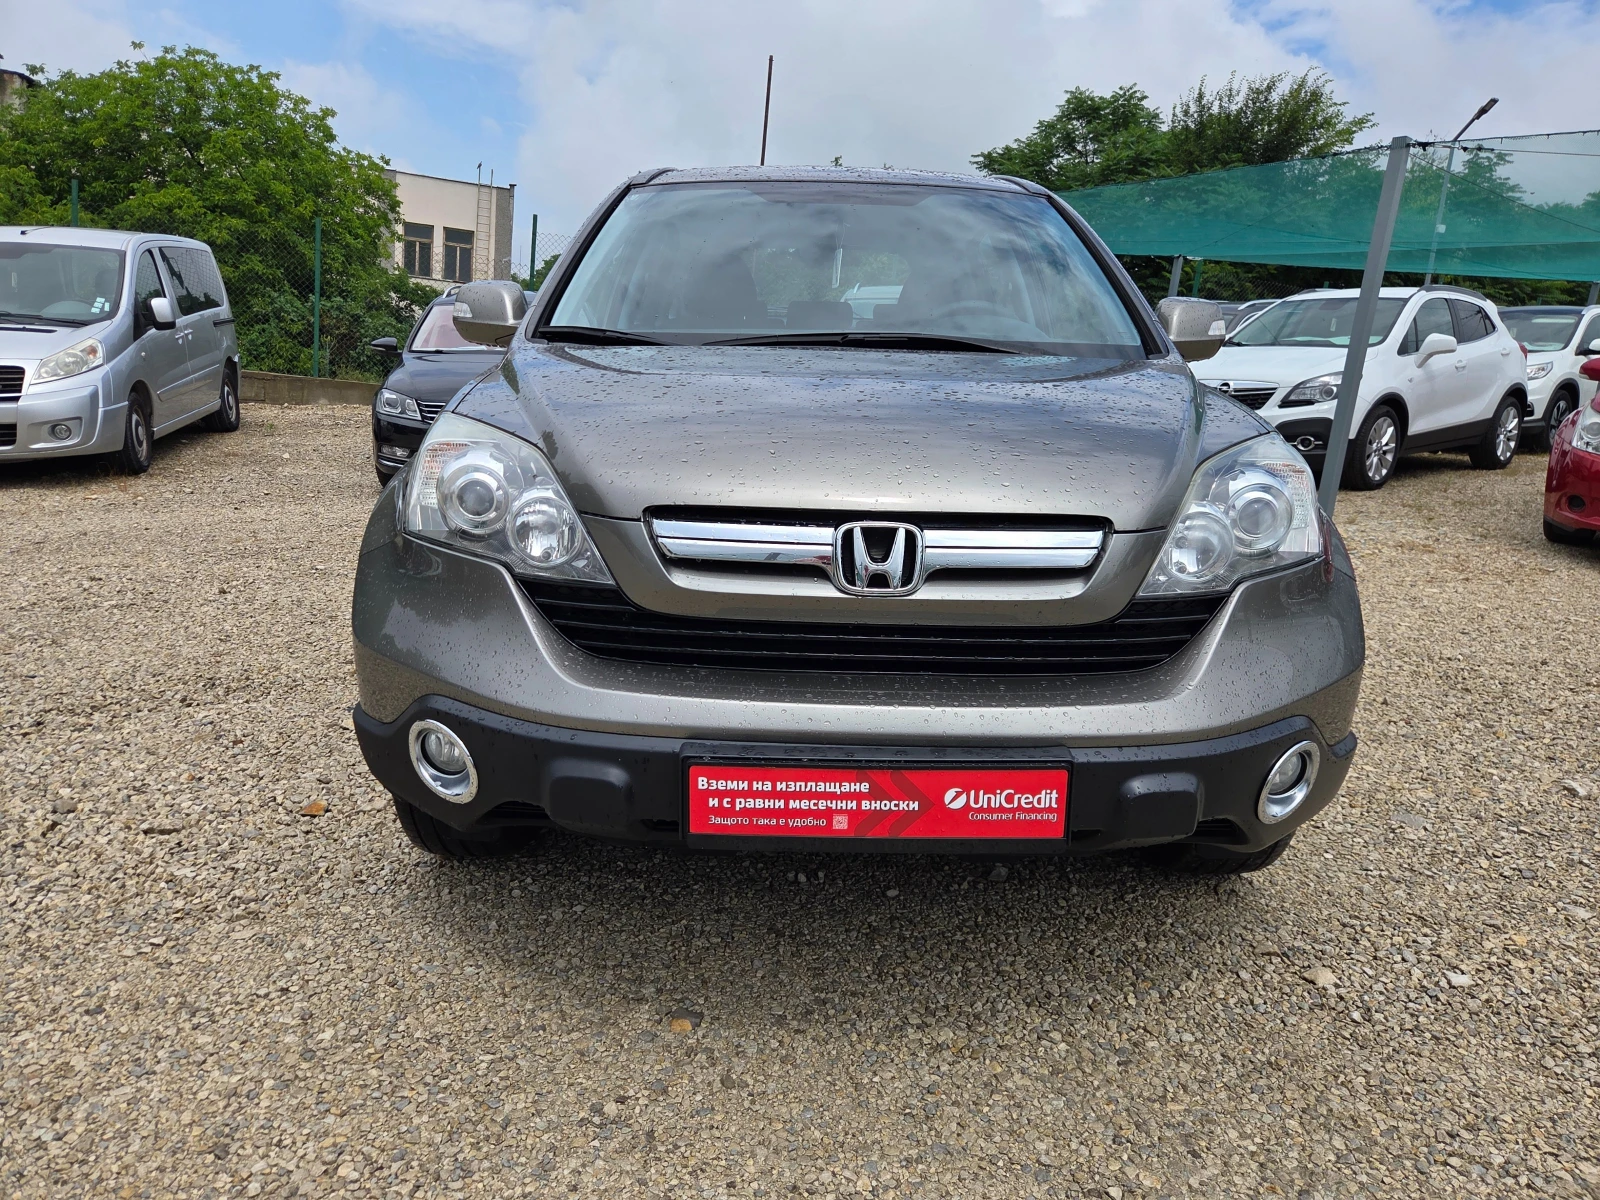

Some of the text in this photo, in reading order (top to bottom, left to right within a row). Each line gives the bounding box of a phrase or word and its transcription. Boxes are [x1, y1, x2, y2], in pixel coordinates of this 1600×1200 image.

[697, 776, 870, 794] Вземи на изплащане
[708, 797, 919, 811] и с равни месечни вноски
[969, 789, 1059, 809] UniCredit
[708, 815, 827, 828] Защото така е удобно
[968, 811, 1058, 823] Consumer Financing
